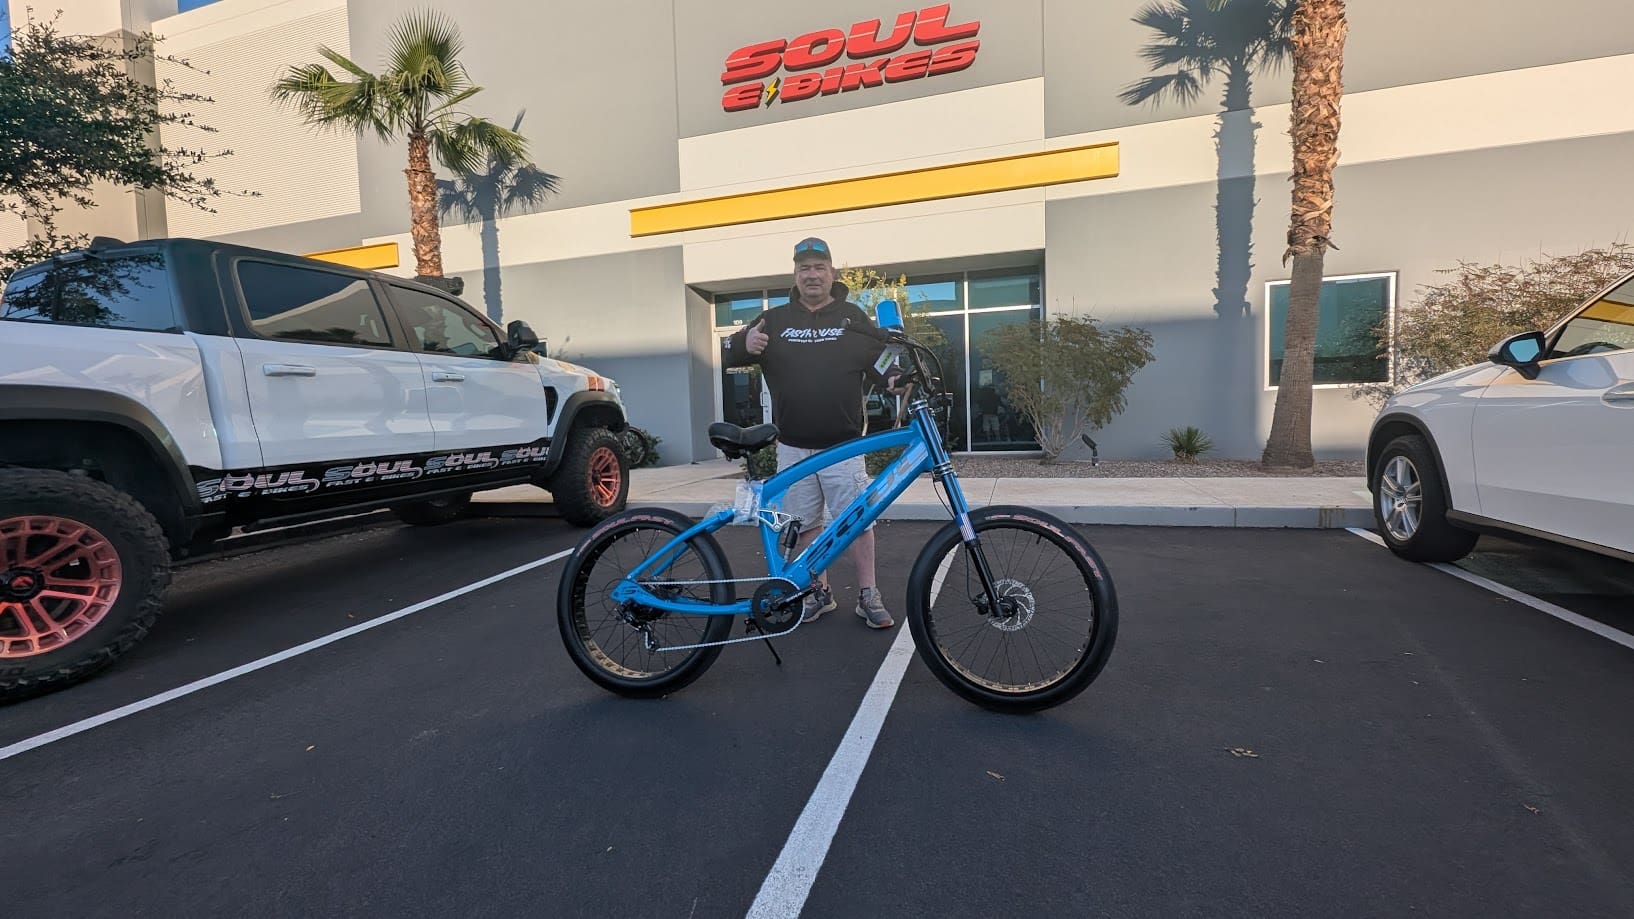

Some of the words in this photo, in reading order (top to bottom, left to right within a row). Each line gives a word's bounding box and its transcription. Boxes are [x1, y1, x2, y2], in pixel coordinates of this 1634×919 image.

[720, 3, 981, 86] SOUL
[780, 39, 981, 104] BIKES
[321, 460, 423, 482] SOUL
[424, 452, 499, 470] SOUL
[197, 470, 320, 497] SOUL
